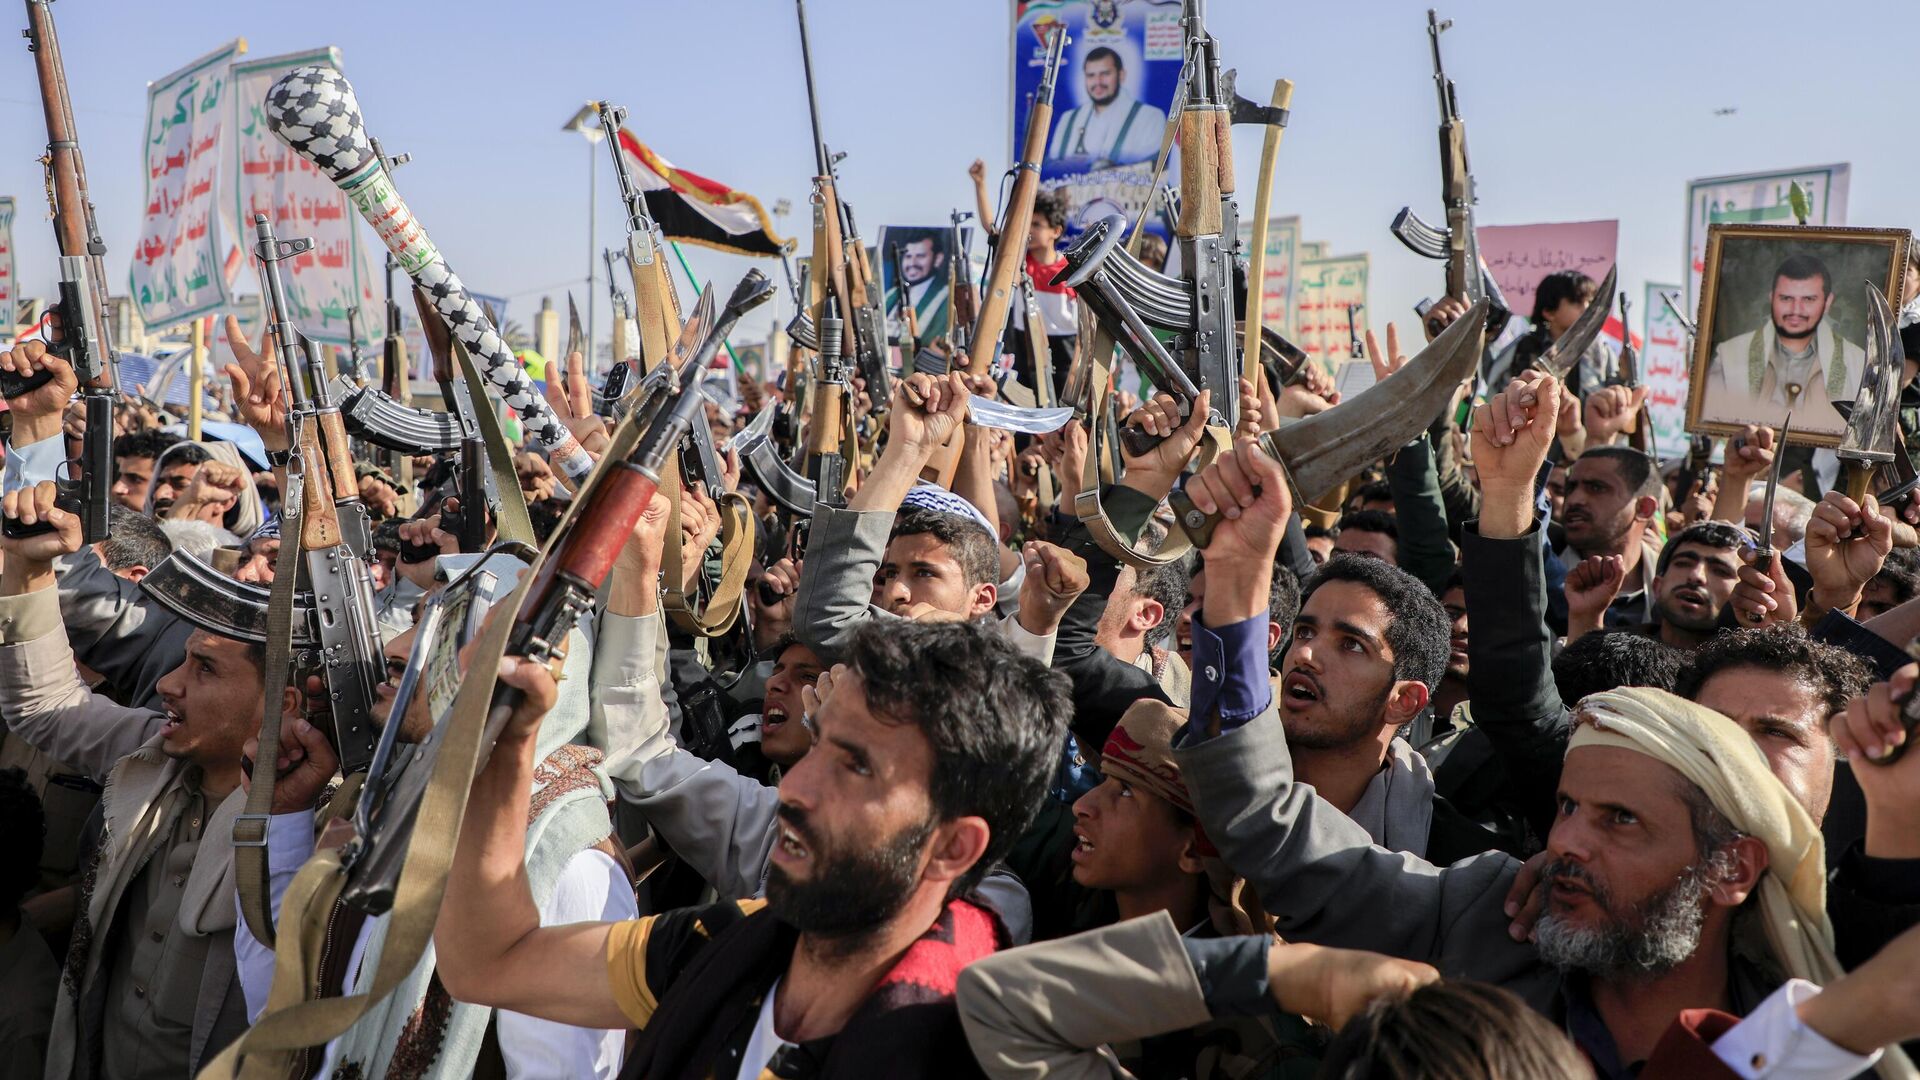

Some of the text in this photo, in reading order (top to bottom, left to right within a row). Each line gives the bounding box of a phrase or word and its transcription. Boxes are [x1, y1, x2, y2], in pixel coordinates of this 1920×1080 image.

[152, 76, 200, 146] أكبر
[300, 186, 347, 227] الموت
[1702, 180, 1815, 226] قطعوا
